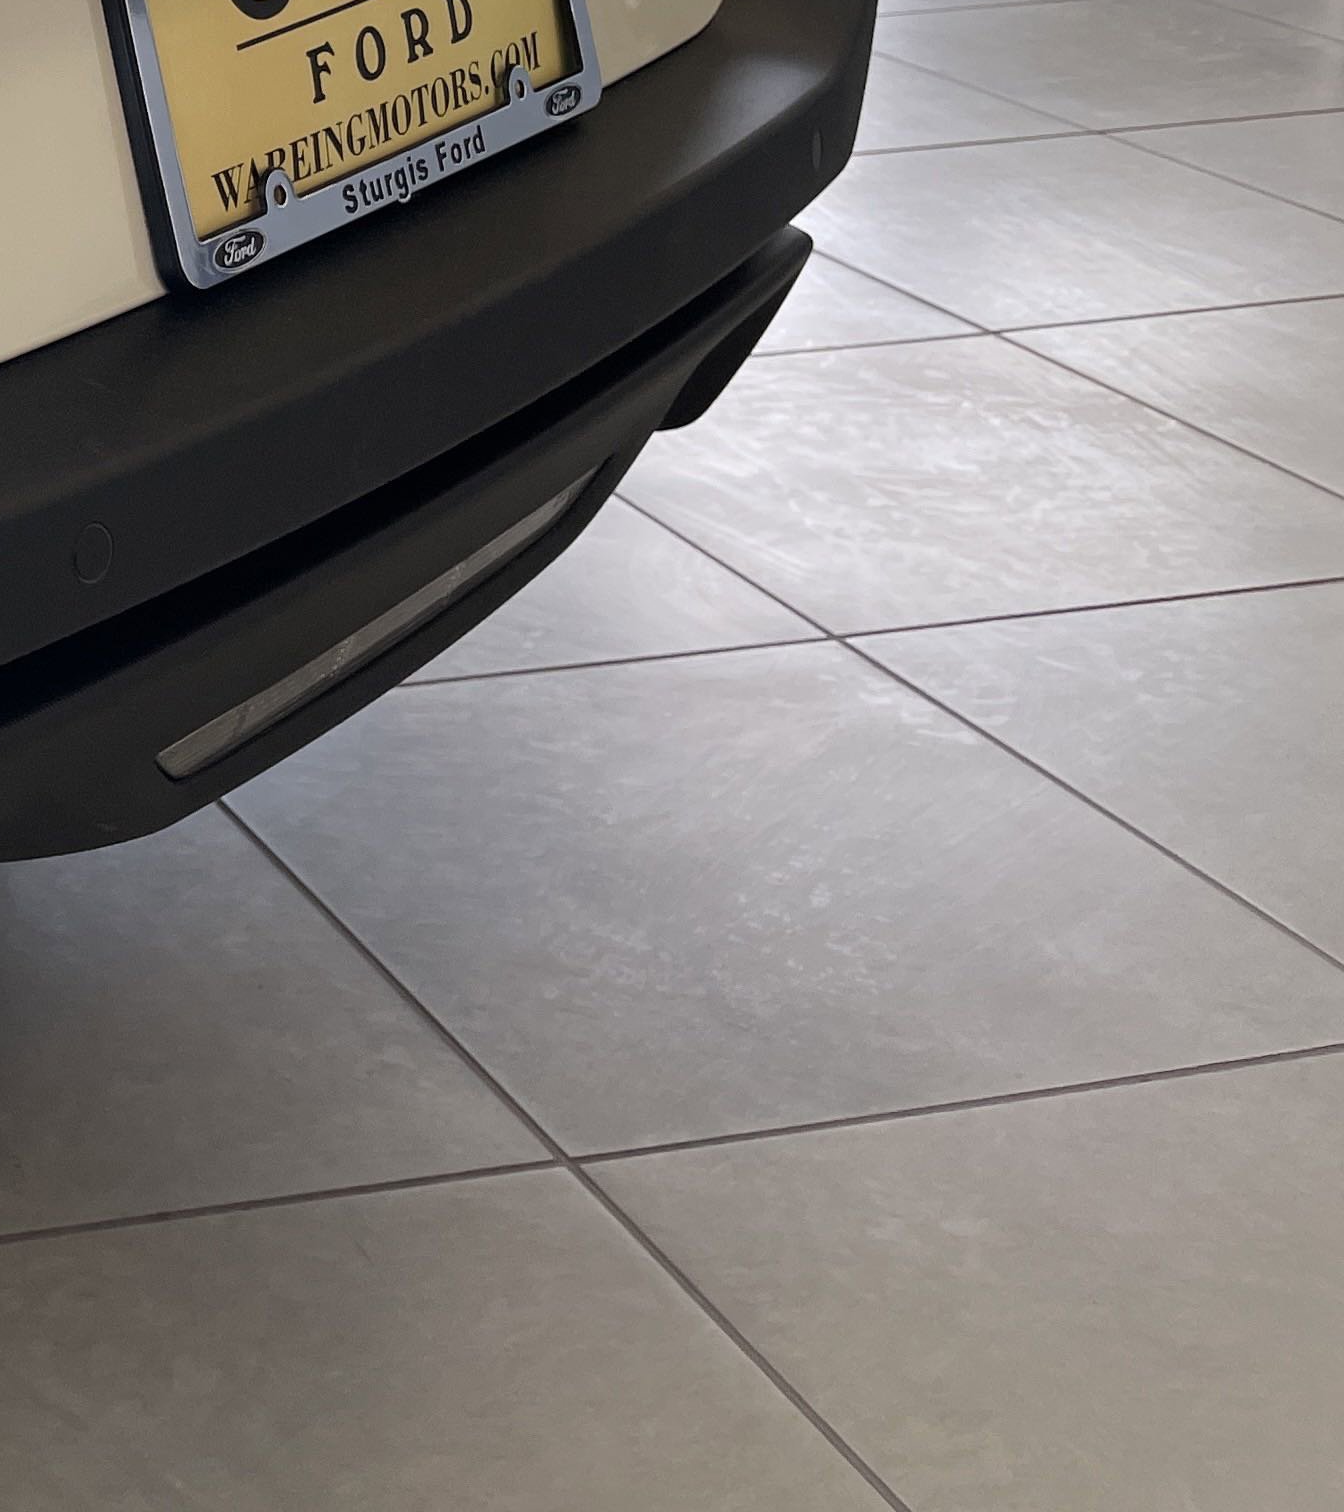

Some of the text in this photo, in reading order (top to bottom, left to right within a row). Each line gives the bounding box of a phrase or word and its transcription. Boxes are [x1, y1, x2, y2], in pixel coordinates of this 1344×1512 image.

[552, 88, 576, 115] Ford
[342, 125, 485, 215] Sturgis Ford
[224, 235, 257, 266] Ford
